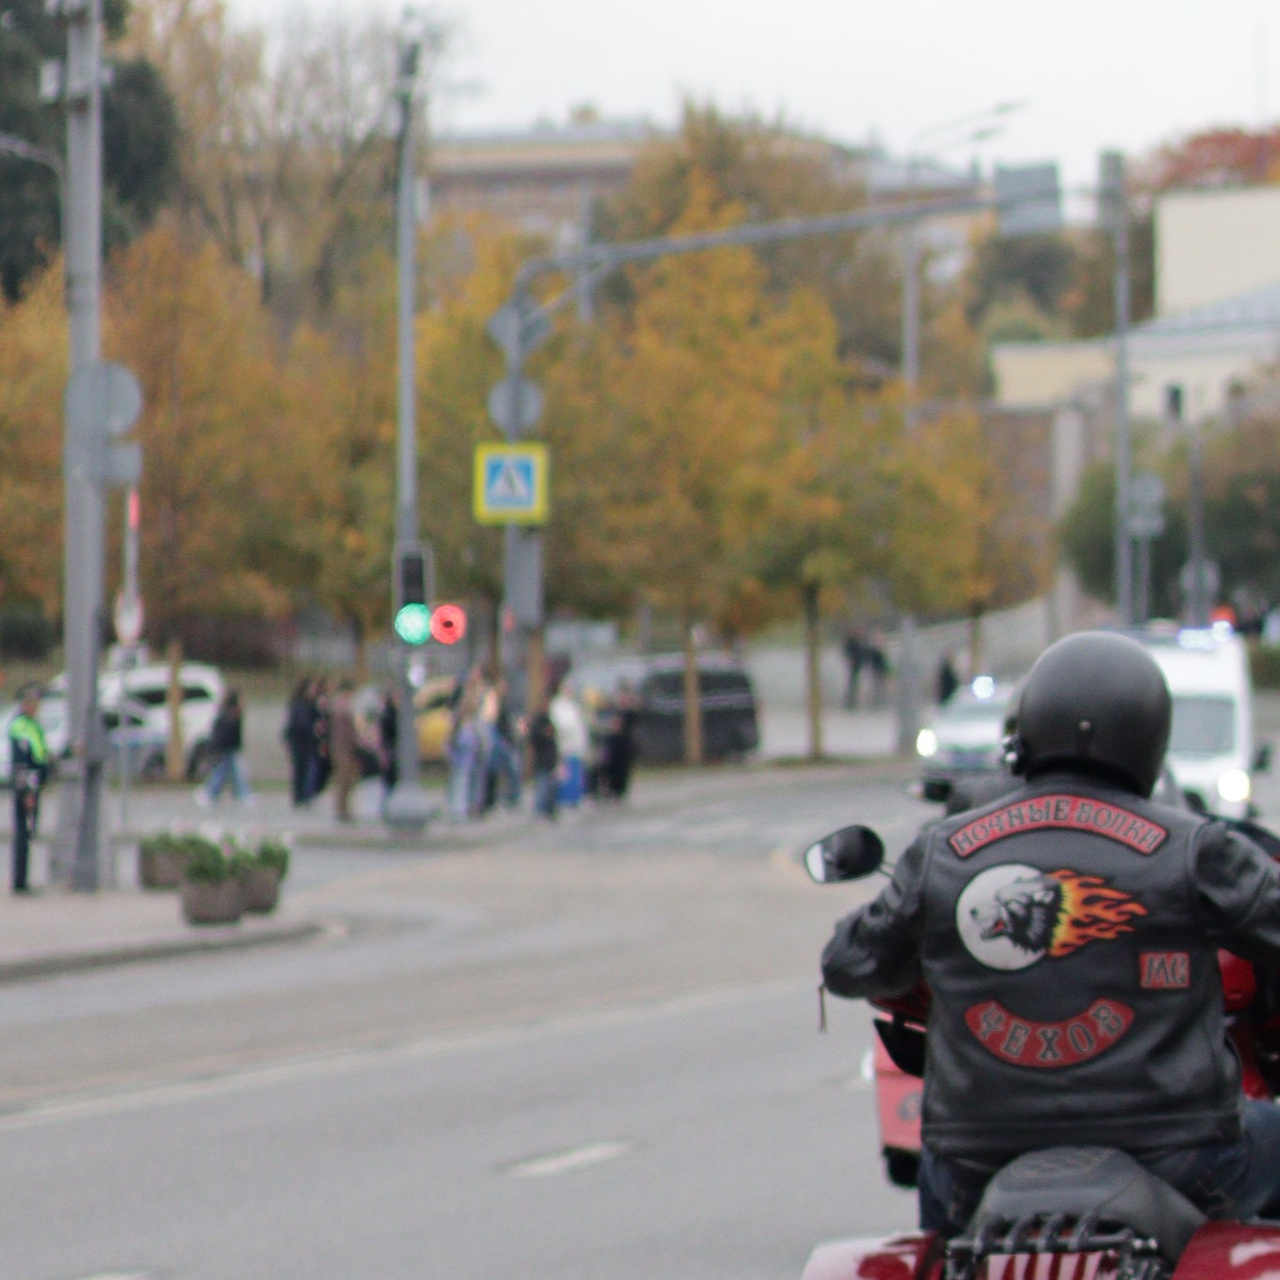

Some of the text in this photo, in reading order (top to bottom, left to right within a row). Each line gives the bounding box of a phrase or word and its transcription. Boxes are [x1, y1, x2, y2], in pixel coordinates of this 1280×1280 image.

[953, 797, 1164, 853] НОЧНЫЕ ВОЛКИ
[980, 1001, 1125, 1062] ЧЕХОВ
